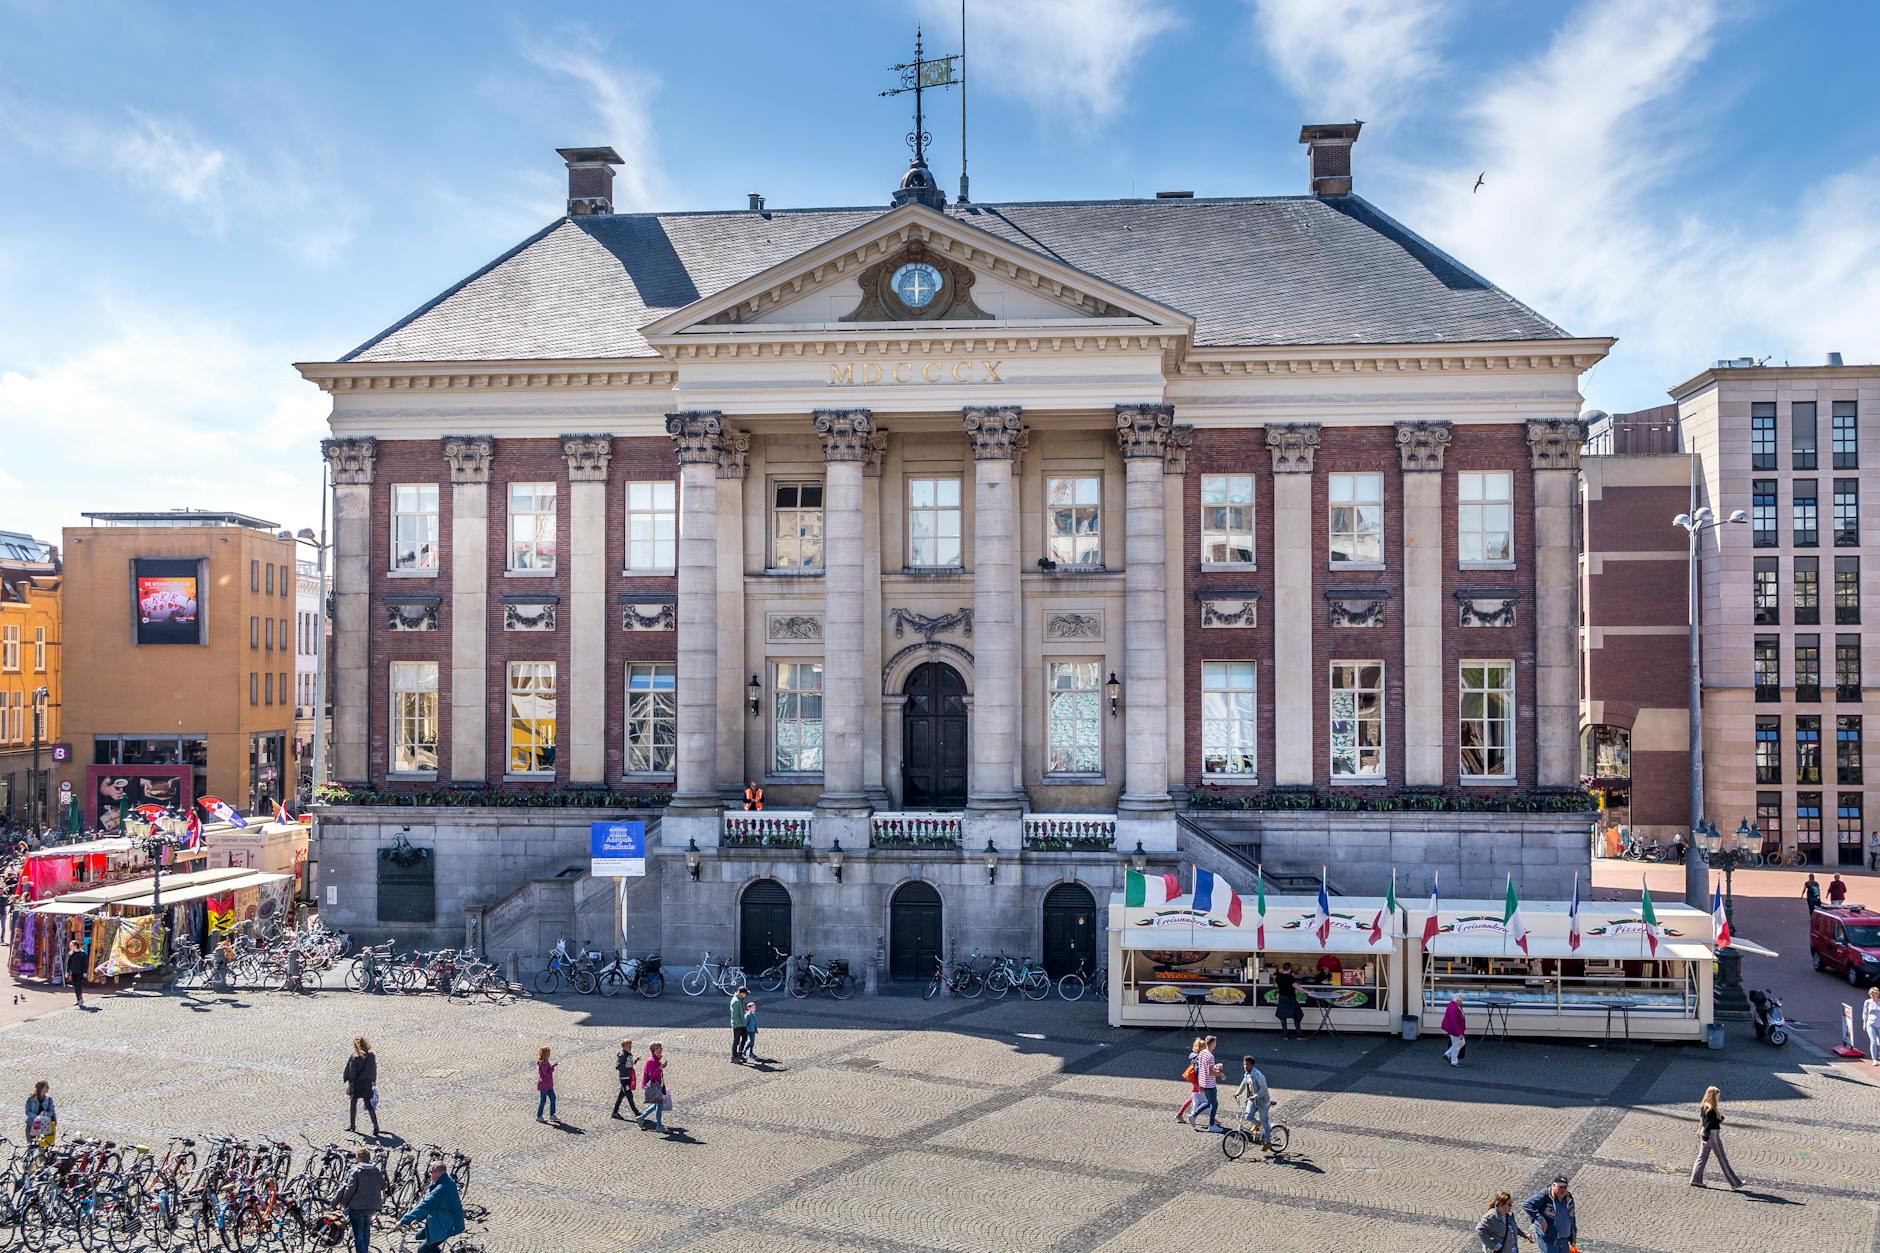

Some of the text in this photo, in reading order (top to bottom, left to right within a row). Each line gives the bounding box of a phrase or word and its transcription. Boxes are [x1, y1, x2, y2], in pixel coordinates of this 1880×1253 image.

[829, 360, 1002, 385] MDCCCX
[1304, 918, 1351, 929] Peria
[1455, 922, 1508, 933] Croissanter
